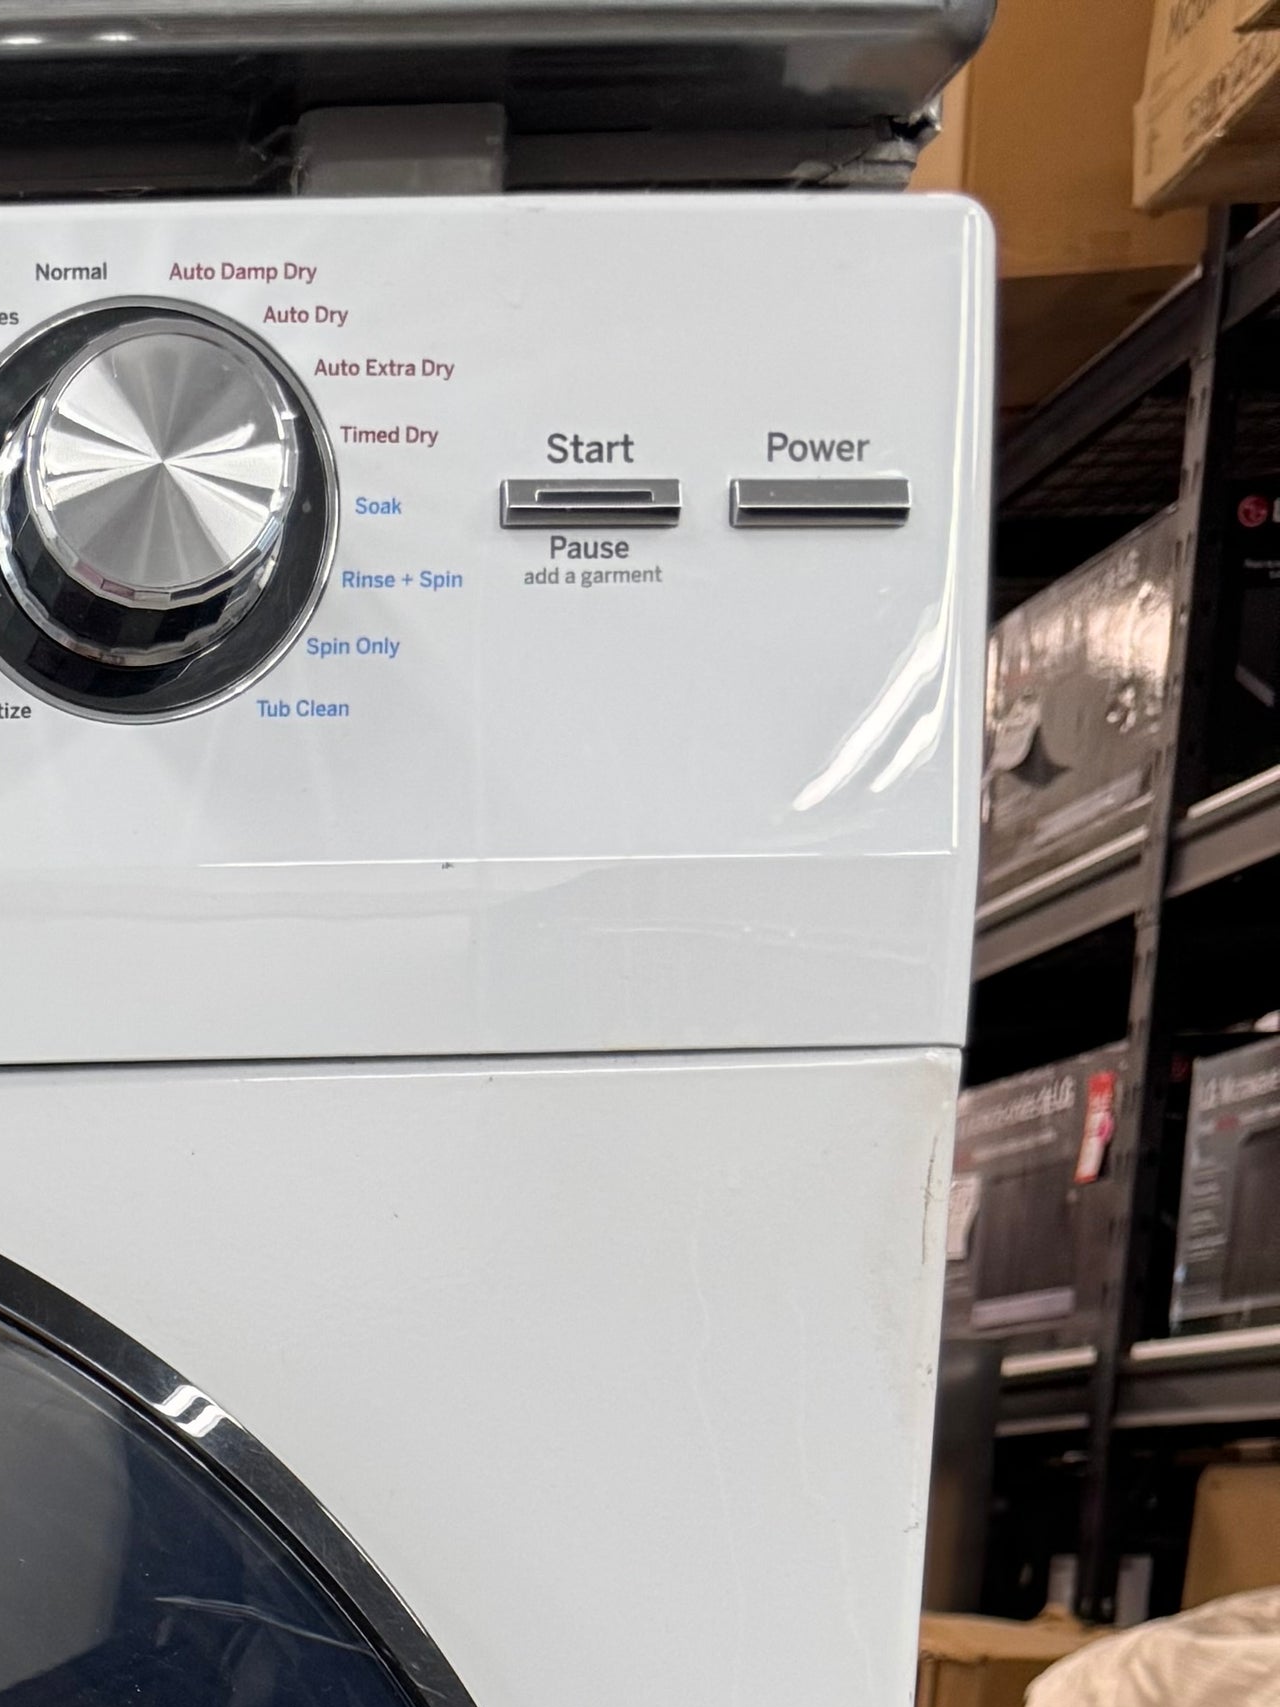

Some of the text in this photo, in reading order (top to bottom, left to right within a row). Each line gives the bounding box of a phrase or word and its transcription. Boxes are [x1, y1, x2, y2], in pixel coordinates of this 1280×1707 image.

[36, 262, 107, 280] Normal
[169, 262, 317, 284] Auto Damp Dry
[263, 306, 348, 327] Auto Dry
[315, 359, 454, 380] Auto Extra Dry
[340, 426, 438, 447] Timed Dry
[768, 432, 870, 462] Power
[547, 433, 634, 463] Start
[356, 497, 401, 514] Soak
[551, 535, 629, 559] Pause
[343, 570, 462, 591] Rinse + Spin
[524, 566, 662, 588] add a garment
[307, 637, 400, 658] Spin Only
[257, 700, 349, 717] Tub Clean
